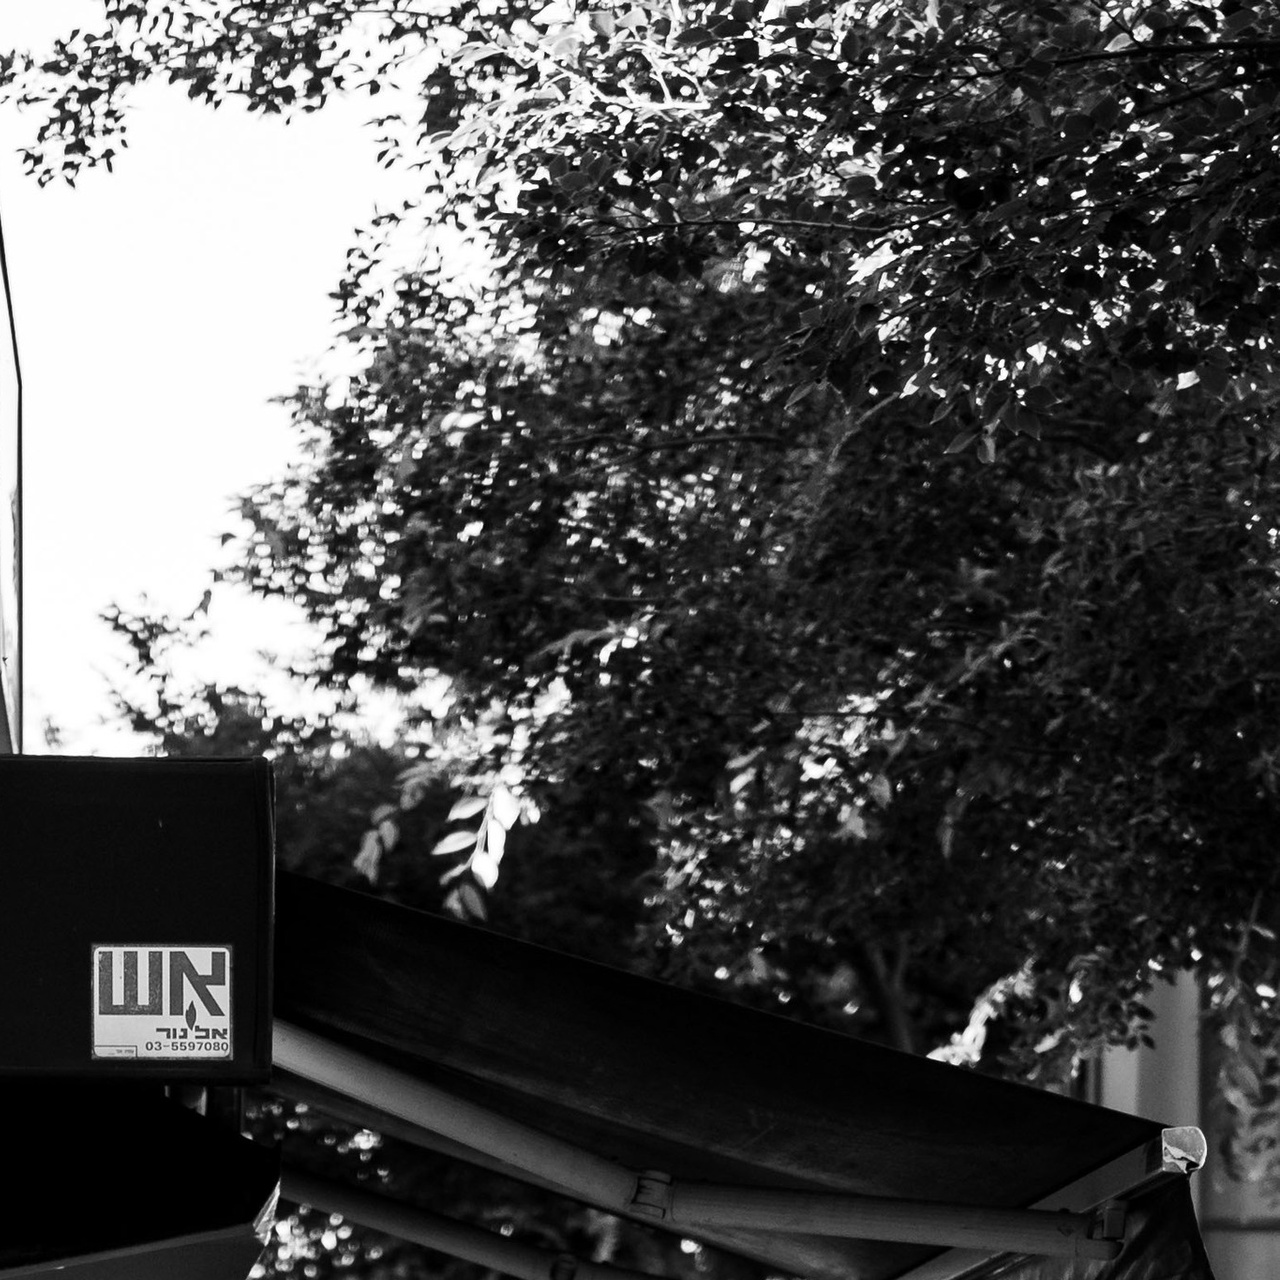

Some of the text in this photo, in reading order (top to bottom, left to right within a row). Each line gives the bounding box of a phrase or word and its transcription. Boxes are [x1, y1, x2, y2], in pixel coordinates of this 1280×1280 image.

[99, 951, 225, 1016] אש
[156, 1025, 228, 1040] אל נור
[145, 1041, 229, 1053] 03-5597080
